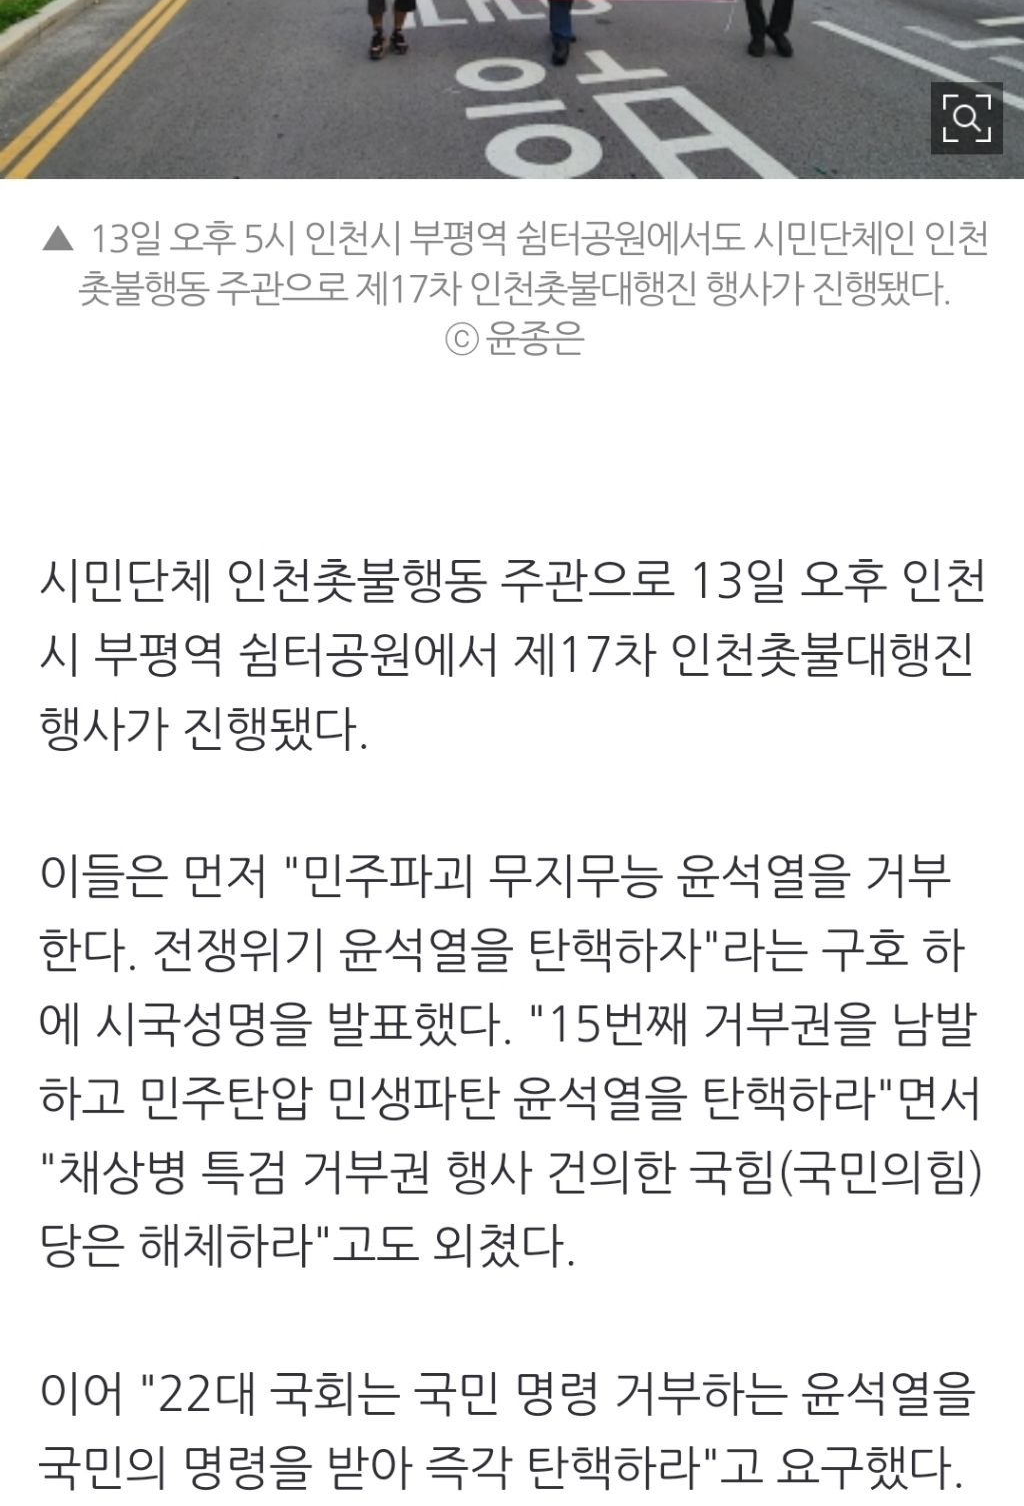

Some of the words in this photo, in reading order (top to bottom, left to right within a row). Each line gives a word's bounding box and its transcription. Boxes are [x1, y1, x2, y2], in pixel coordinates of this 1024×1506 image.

[94, 221, 160, 256] 13일
[170, 221, 236, 256] 오후
[246, 221, 293, 256] 5시
[306, 221, 399, 256] 인천시
[410, 221, 505, 256] 부평역
[517, 221, 745, 256] 쉼터공원에서도
[754, 221, 914, 256] 시민단체인
[926, 221, 987, 255] 인천
[78, 271, 211, 307] 촛불행동
[216, 271, 349, 307] 주관으로
[356, 271, 462, 306] 제17차
[470, 271, 697, 306] 인천촛불대행진
[706, 271, 805, 306] 행사가
[813, 271, 950, 307] 진행됐다.
[486, 321, 585, 356] 윤종은
[41, 559, 209, 603] 시민단체
[229, 558, 487, 603] 인천촛불행동
[501, 559, 675, 603] 주관으로
[694, 559, 783, 603] 13일
[801, 559, 887, 603] 오후
[904, 559, 984, 602] 인천
[41, 633, 76, 677] 시
[95, 633, 220, 677] 부평역
[240, 633, 495, 677] 쉼터공원에서
[514, 633, 657, 677] 제17차
[672, 632, 971, 677] 인천촛불대행진
[40, 707, 169, 751] 행사가
[185, 707, 367, 751] 진행됐다.
[42, 854, 168, 898] 이들은
[186, 854, 263, 898] 먼저
[286, 854, 471, 898] "민주파괴
[489, 854, 663, 899] 무지무능
[677, 854, 851, 898] 윤석열을
[867, 854, 951, 898] 거부
[39, 928, 135, 973] 한다.
[154, 928, 321, 973] 전쟁위기
[340, 928, 513, 973] 윤석열을
[531, 928, 808, 973] 탄핵하자"라는
[822, 929, 908, 972] 구호
[923, 928, 965, 973] 하
[40, 1002, 78, 1047] 에
[97, 1002, 312, 1048] 시국성명을
[329, 1002, 510, 1047] 발표했다.
[531, 1002, 686, 1047] "15번째
[705, 1002, 876, 1047] 거부권을
[895, 1002, 978, 1047] 남발
[40, 1076, 125, 1121] 하고
[142, 1076, 313, 1121] 민주탄압
[330, 1076, 500, 1121] 민생파탄
[514, 1076, 687, 1121] 윤석열을
[705, 1076, 977, 1121] 탄핵하라"면서
[42, 1150, 184, 1195] "채상병
[202, 1150, 283, 1196] 특검
[305, 1150, 428, 1195] 거부권
[447, 1150, 532, 1195] 행사
[549, 1150, 677, 1195] 건의한
[689, 1150, 981, 1197] 국힘(국민의힘)
[42, 1224, 125, 1268] 당은
[139, 1224, 419, 1268] 해체하라"고도
[434, 1224, 574, 1268] 외쳤다.
[42, 1372, 120, 1416] 이어
[142, 1372, 253, 1416] "22대
[270, 1372, 400, 1417] 국회는
[414, 1372, 497, 1417] 국민
[518, 1372, 596, 1416] 명령
[617, 1372, 788, 1416] 거부하는
[802, 1372, 976, 1416] 윤석열을
[39, 1446, 164, 1491] 국민의
[186, 1446, 312, 1490] 명령을
[329, 1446, 413, 1490] 받아
[426, 1446, 513, 1490] 즉각
[530, 1446, 763, 1491] 탄핵하라"고
[777, 1446, 962, 1490] 요구했다.
